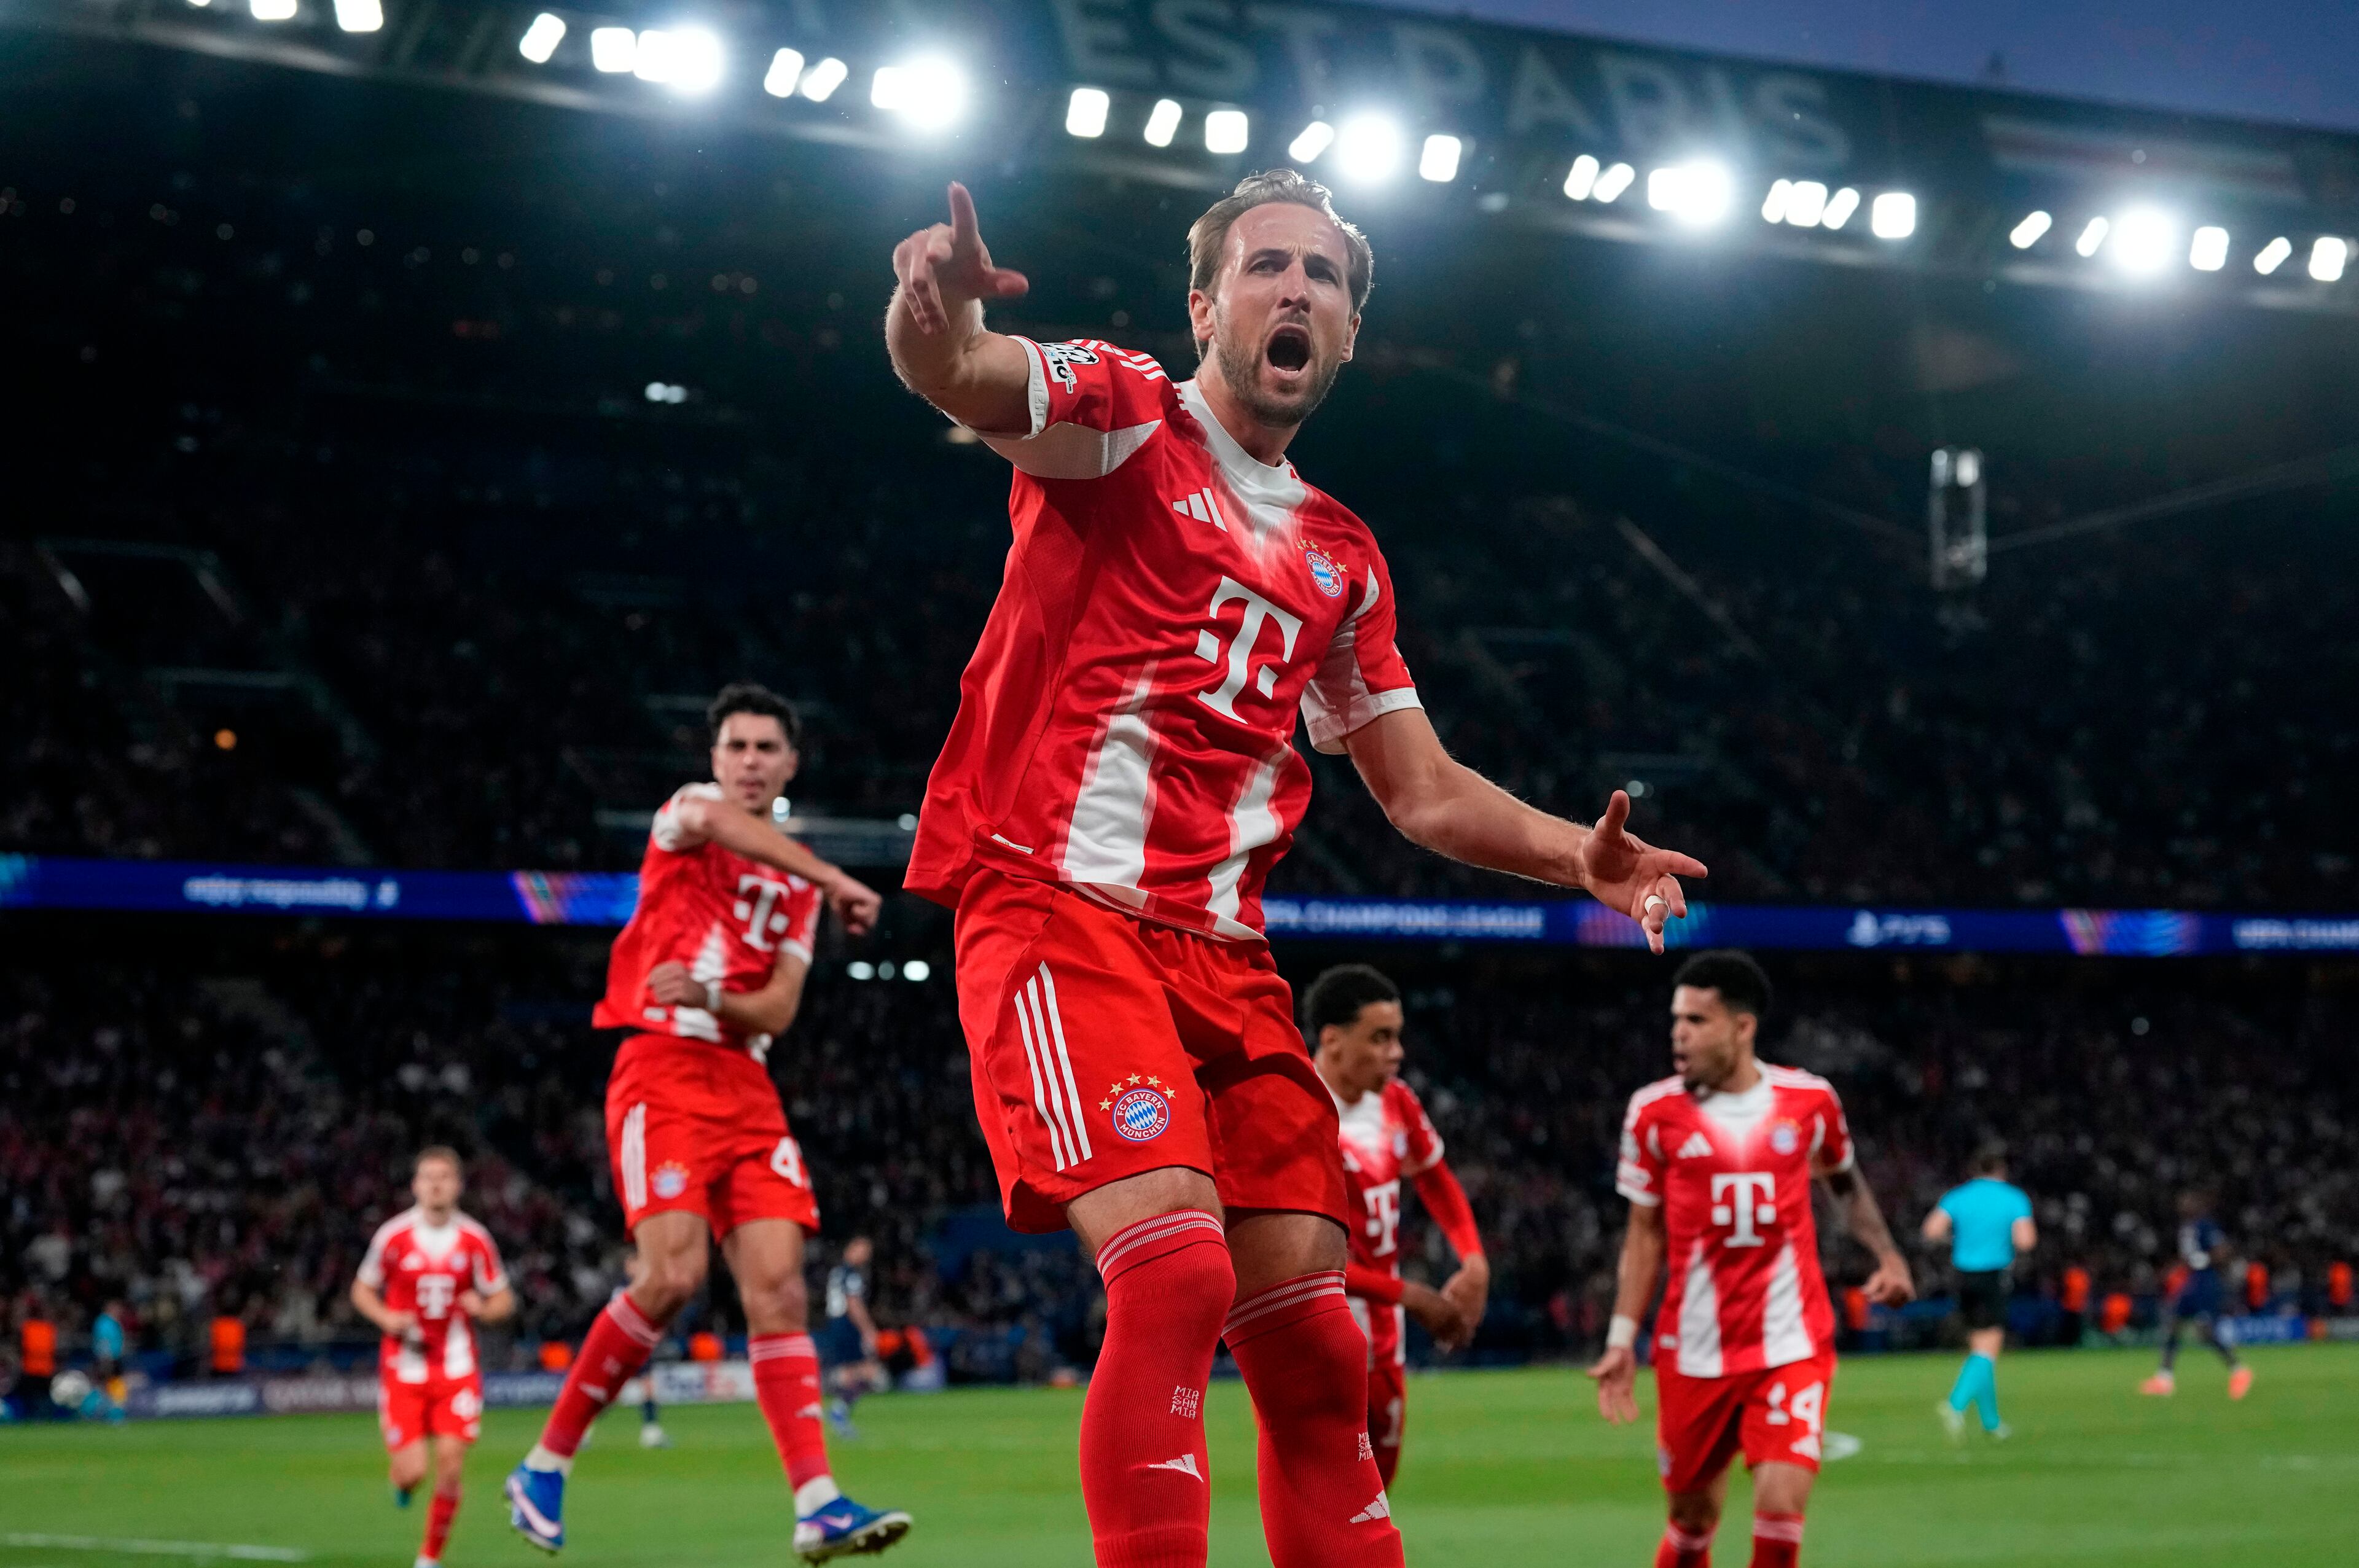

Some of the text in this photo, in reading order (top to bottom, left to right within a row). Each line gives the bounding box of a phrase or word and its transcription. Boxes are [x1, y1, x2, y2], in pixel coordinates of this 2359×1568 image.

[1390, 25, 1850, 165] PARIS
[1310, 555, 1337, 577] BAYERN
[1195, 575, 1303, 724] T
[733, 874, 790, 951] T
[1117, 1093, 1164, 1116] FC BAYERN
[1119, 1117, 1166, 1138] MÜNCHEN
[770, 1135, 812, 1190] 4
[1711, 1172, 1776, 1248] T
[1170, 1404, 1195, 1419] MIA
[1172, 1395, 1197, 1410] SAN
[1174, 1385, 1199, 1401] MIA
[1766, 1381, 1825, 1433] 14
